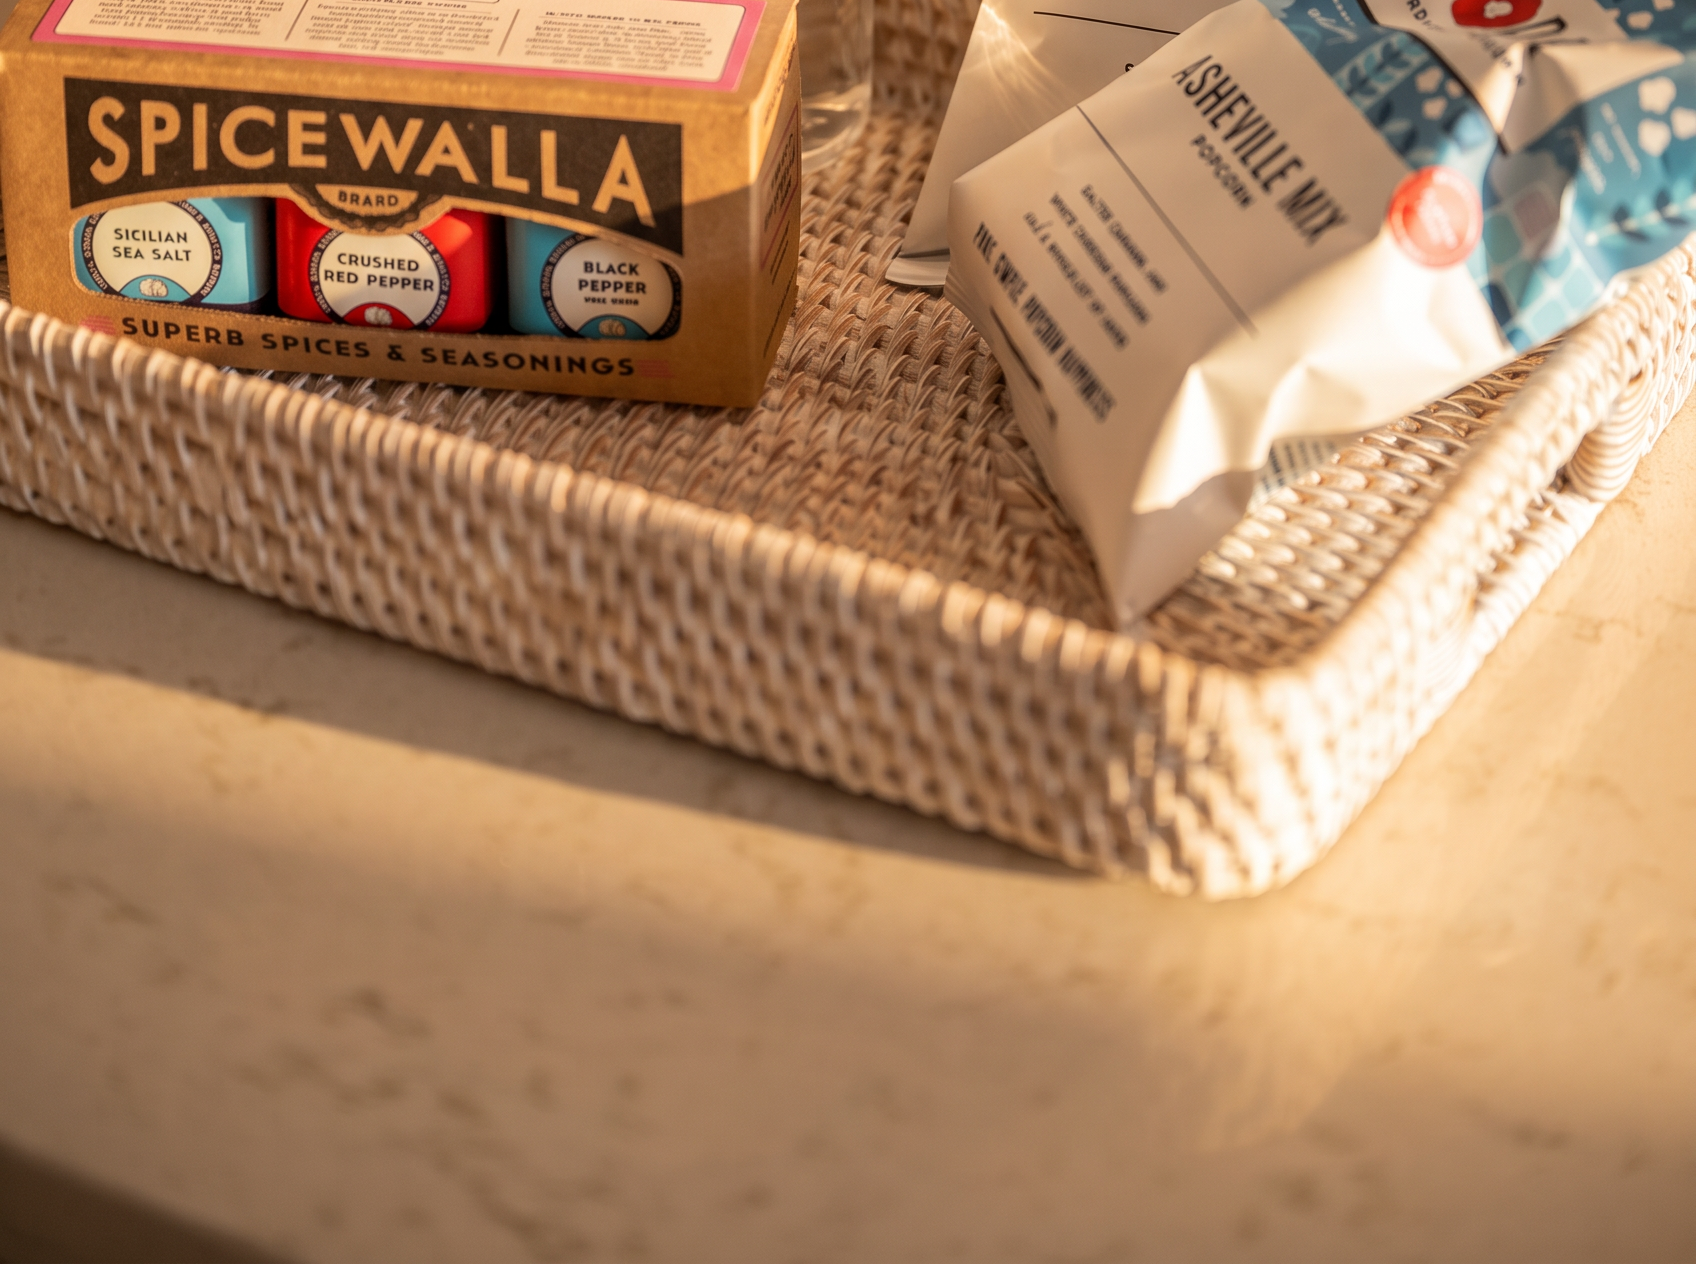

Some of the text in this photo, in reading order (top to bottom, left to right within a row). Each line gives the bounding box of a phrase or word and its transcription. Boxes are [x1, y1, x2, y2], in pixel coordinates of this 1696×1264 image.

[1171, 54, 1349, 247] ASHEVILLE MIX
[87, 95, 657, 228] SPICEWALLA
[114, 228, 189, 244] SICILIAN
[112, 246, 192, 262] SEA SALT
[337, 252, 420, 273] CRUSHED
[583, 261, 640, 276] BLACK
[324, 269, 435, 292] RED PEPPER
[578, 279, 647, 295] PEPPER
[121, 316, 635, 377] SUPERB SPICES & SEASONINGS
